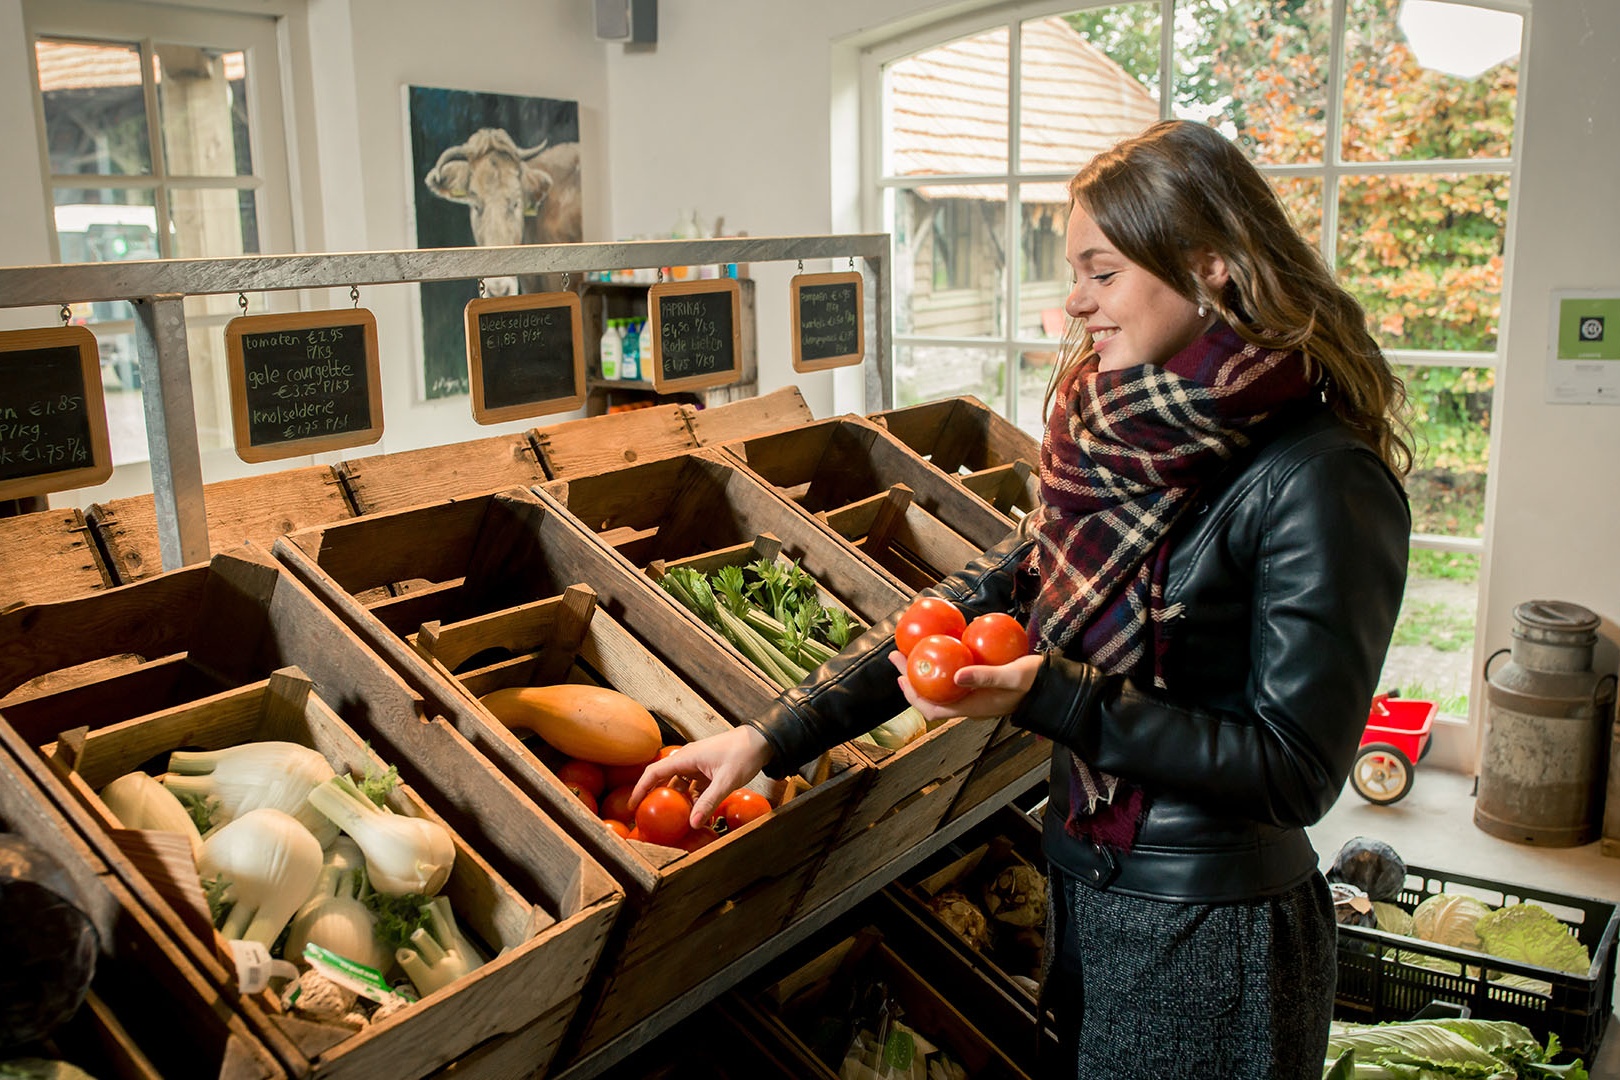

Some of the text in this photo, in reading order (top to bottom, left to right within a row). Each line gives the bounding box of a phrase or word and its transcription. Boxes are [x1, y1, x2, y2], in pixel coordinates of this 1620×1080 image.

[246, 333, 300, 349] tomaten
[248, 360, 354, 389] gele courgette
[28, 394, 83, 416] €1.85
[19, 443, 65, 465] €1.75
